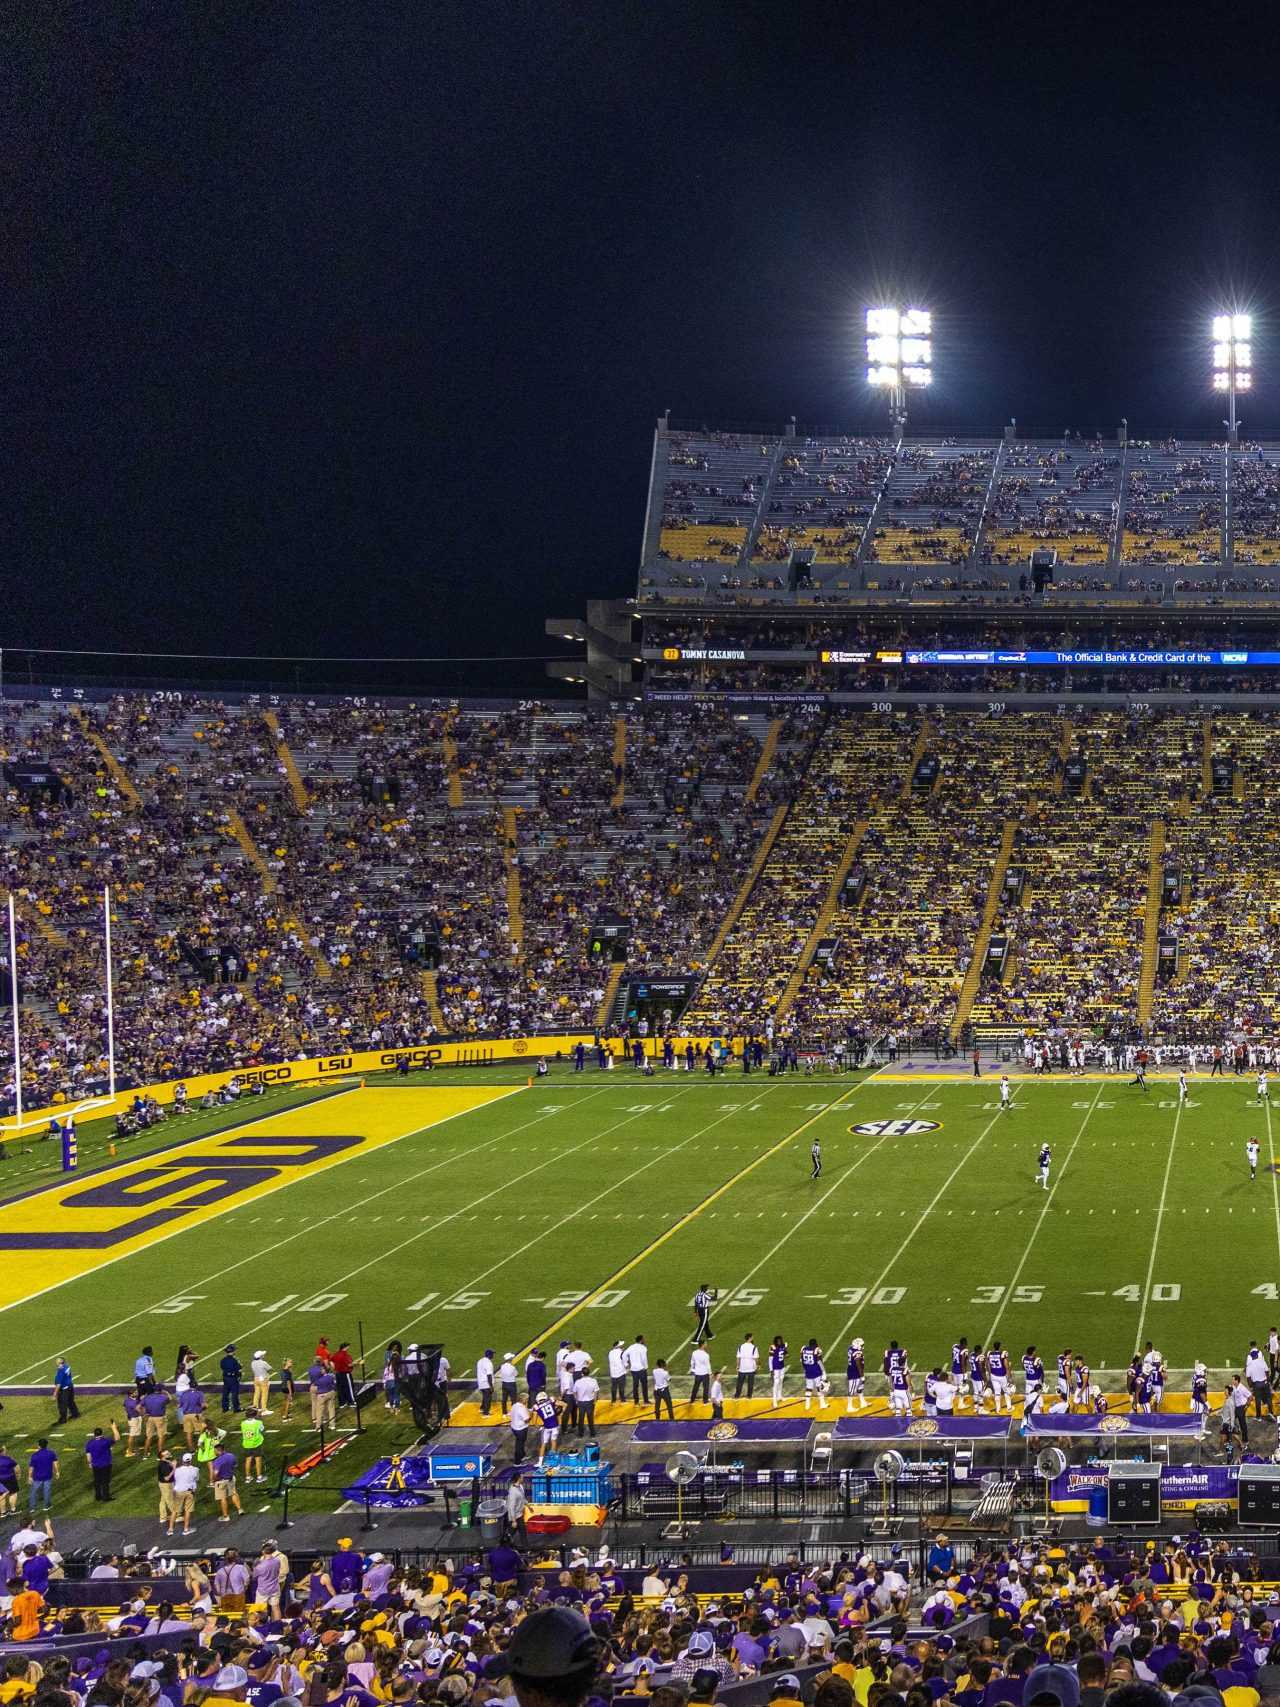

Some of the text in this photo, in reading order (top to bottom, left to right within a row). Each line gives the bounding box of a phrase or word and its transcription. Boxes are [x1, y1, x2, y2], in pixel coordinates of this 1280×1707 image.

[681, 650, 745, 659] TOMMY CASANOVA
[1056, 653, 1211, 662] The Official Bank & Credit Card of the
[344, 697, 367, 707] 41
[801, 703, 820, 713] 244
[872, 703, 892, 713] 300
[988, 703, 1005, 712] 301
[318, 1056, 353, 1073] LSU
[381, 1049, 442, 1066] GEICO
[235, 1067, 291, 1085] GEICO
[626, 1104, 673, 1113] 10
[805, 1103, 856, 1111] 20
[1072, 1101, 1118, 1109] 35
[853, 1120, 940, 1136] SEC
[69, 1132, 79, 1167] LSU
[0, 1136, 367, 1250] LSU
[543, 1290, 631, 1308] 20
[828, 1287, 908, 1305] 30
[970, 1285, 1046, 1303] 35
[1112, 1284, 1182, 1301] 40
[147, 1295, 208, 1314] 5
[260, 1294, 349, 1313] 10
[406, 1292, 492, 1310] 15
[991, 1360, 1002, 1368] 53
[892, 1374, 904, 1385] 73
[541, 1404, 555, 1419] 19
[1161, 1474, 1208, 1485] uthernAIR
